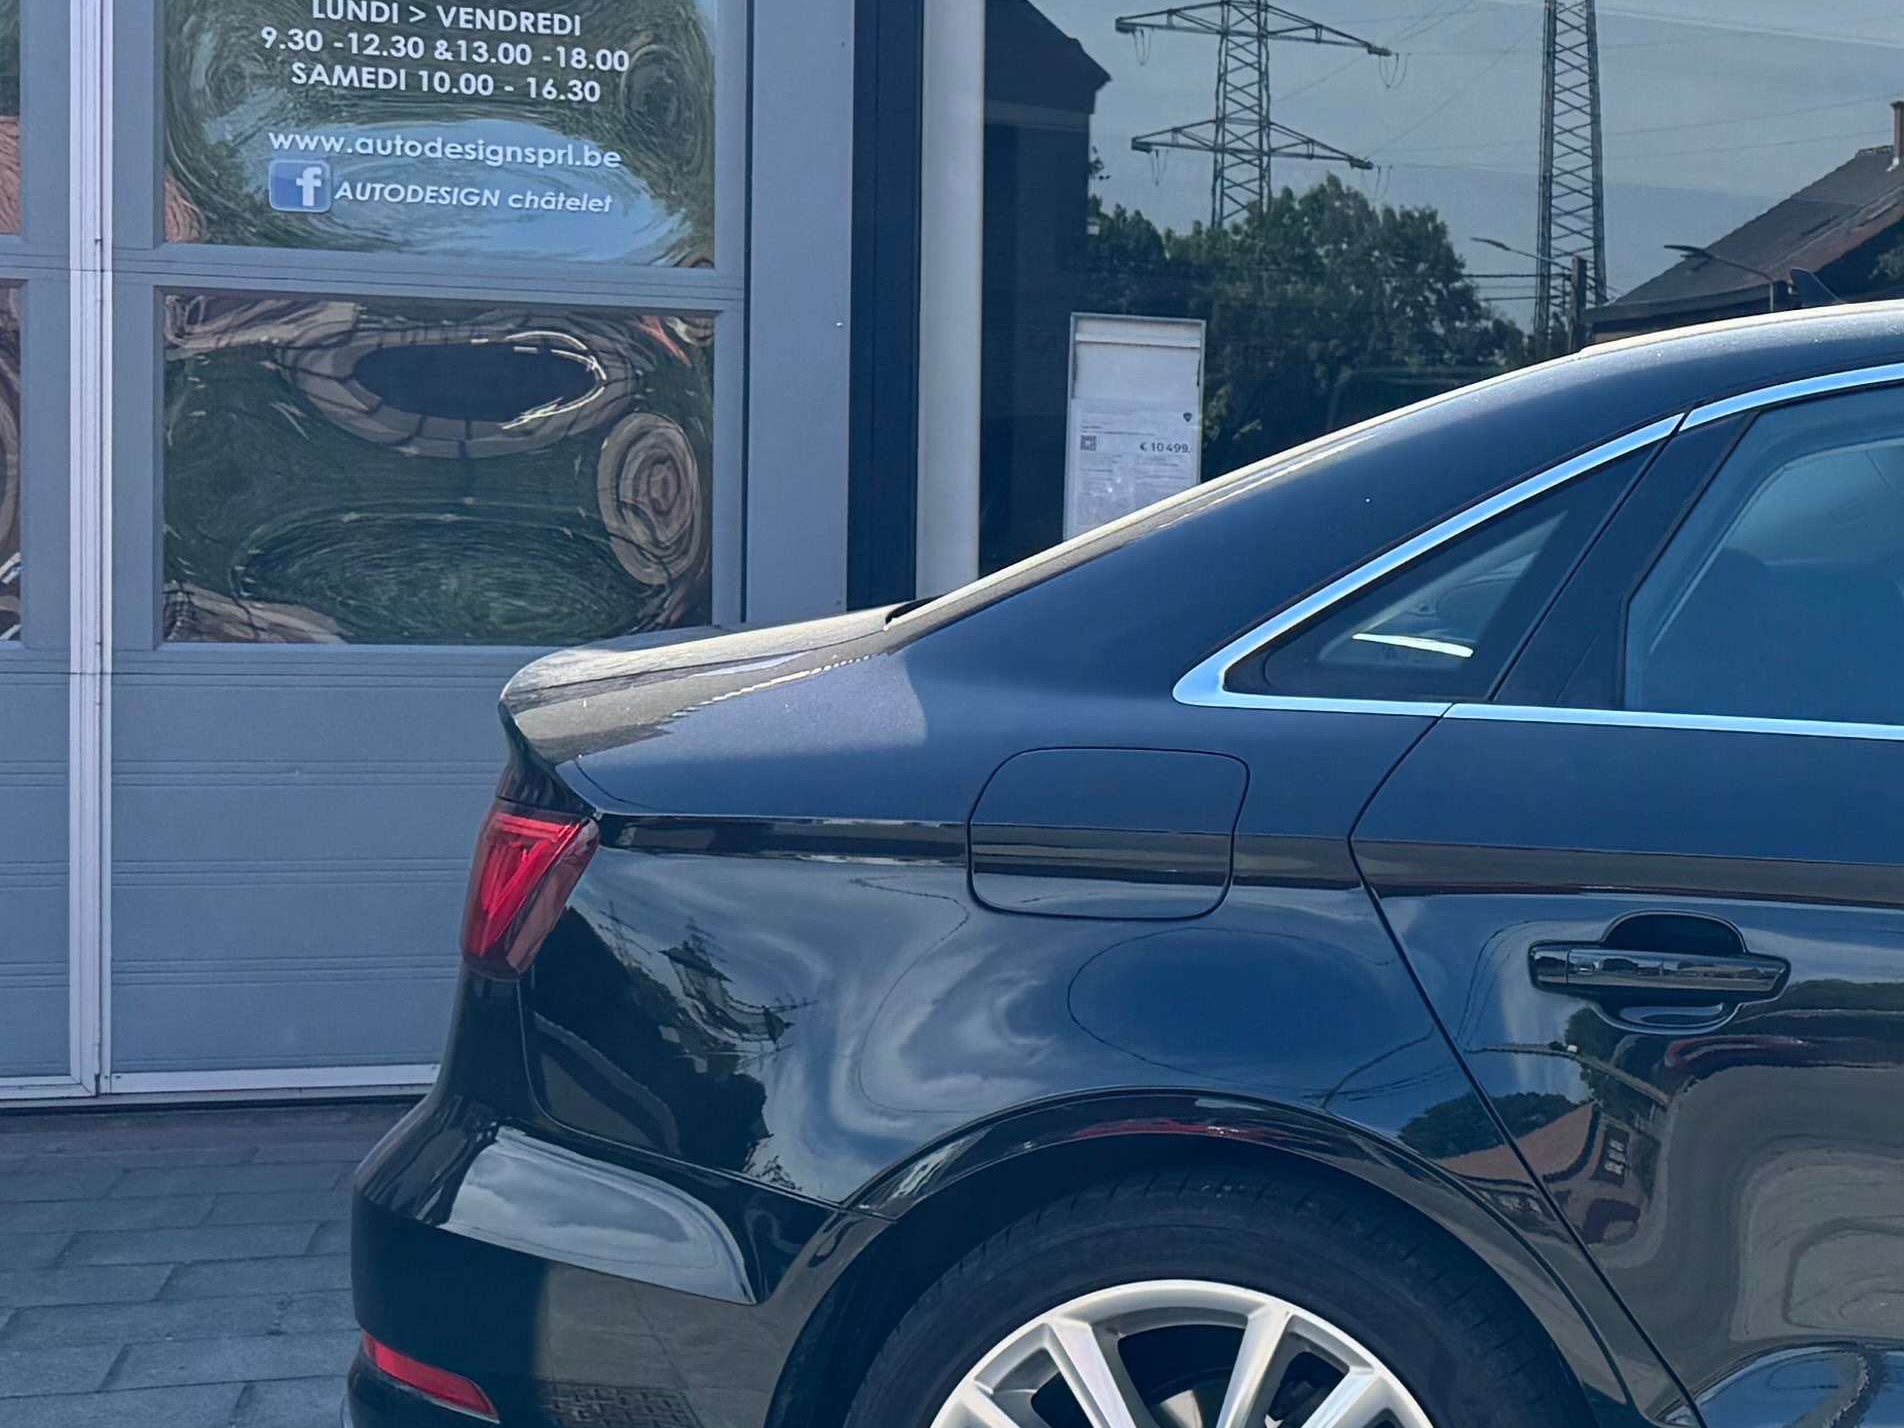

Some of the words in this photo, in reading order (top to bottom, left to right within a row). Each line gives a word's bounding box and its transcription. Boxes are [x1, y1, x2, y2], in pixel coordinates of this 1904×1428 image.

[436, 5, 581, 36] VENDREDI
[260, 26, 323, 52] 9.30
[291, 62, 406, 91] SAMEDI
[418, 70, 494, 96] 10.00
[526, 77, 601, 102] 16.30
[268, 132, 622, 168] www.autodesignsprl.be
[334, 182, 500, 208] AUTODESIGN
[508, 189, 613, 213] châtelet
